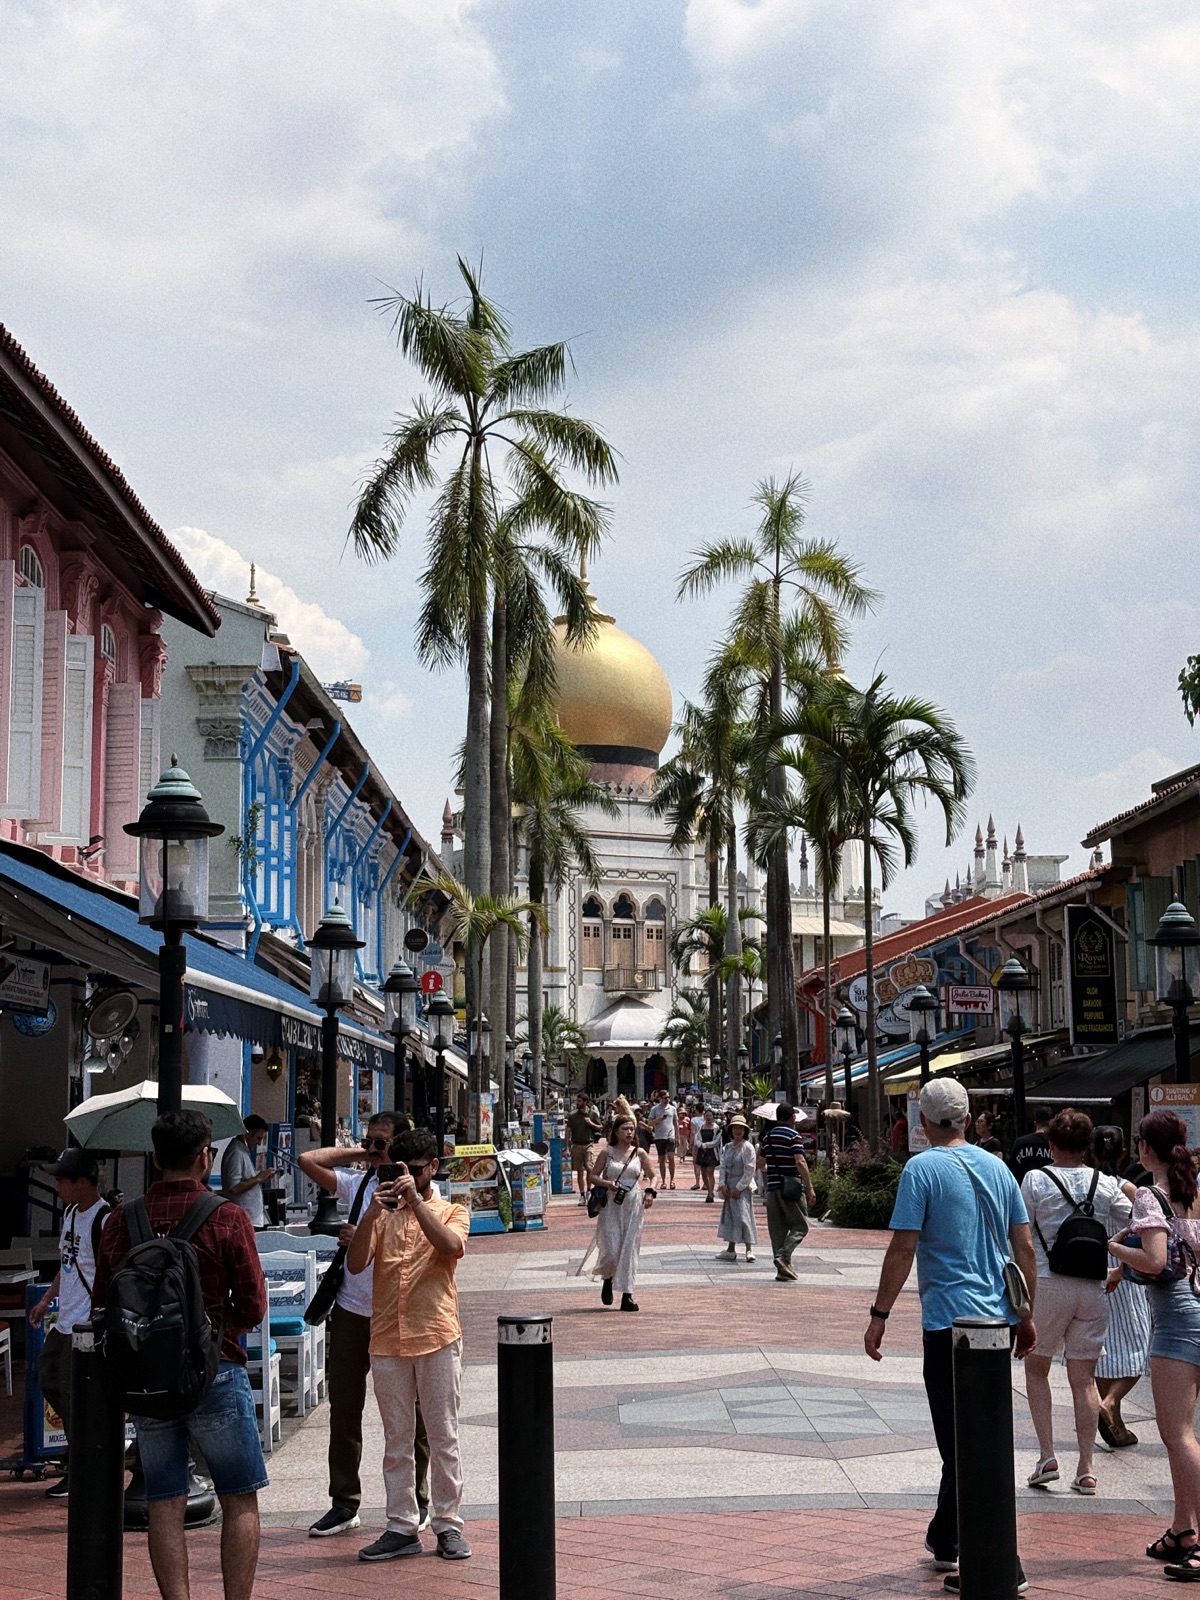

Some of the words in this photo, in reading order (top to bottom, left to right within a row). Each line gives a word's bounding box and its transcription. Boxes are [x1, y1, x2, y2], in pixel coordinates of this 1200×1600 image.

[1077, 952, 1106, 964] Royal
[969, 990, 988, 998] Bakes
[1083, 1011, 1105, 1020] PERFUMES
[1076, 1023, 1088, 1032] HOME
[1088, 1023, 1114, 1032] FRAGRANCES
[48, 1434, 67, 1443] MIXED
